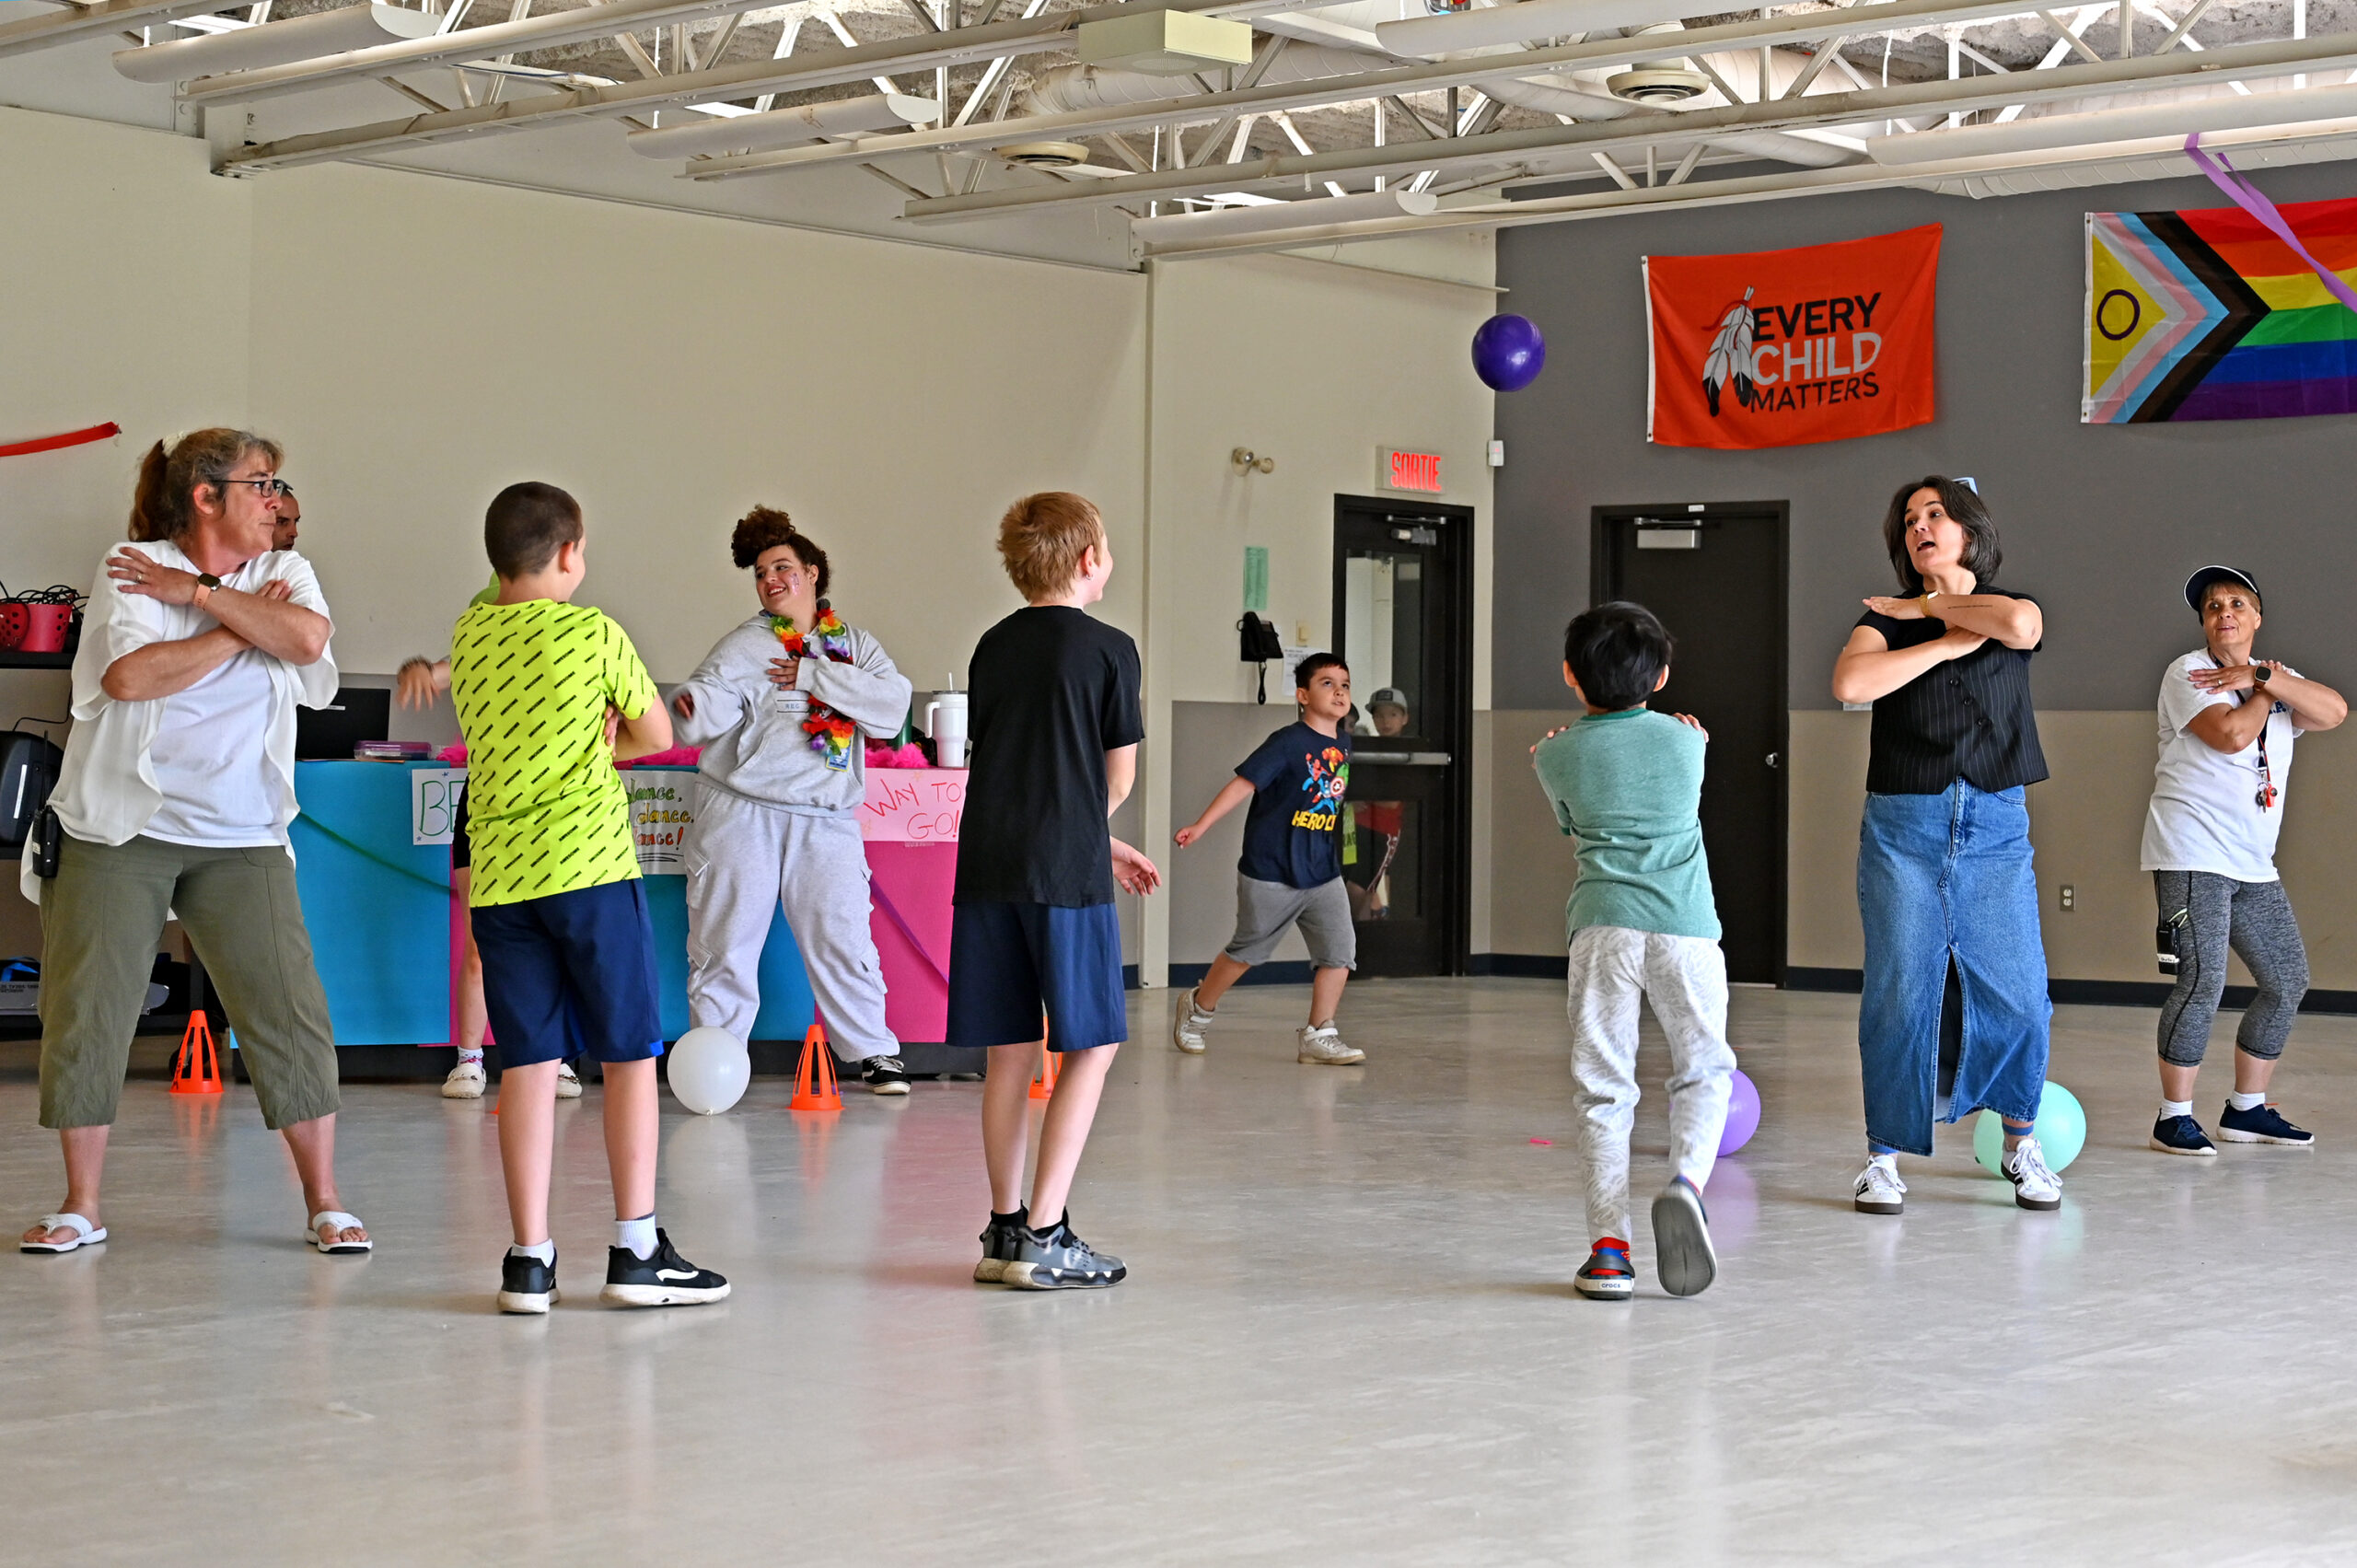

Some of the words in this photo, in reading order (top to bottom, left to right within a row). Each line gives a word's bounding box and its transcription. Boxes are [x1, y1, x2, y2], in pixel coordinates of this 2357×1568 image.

[1752, 291, 1882, 343] EVERY
[1751, 331, 1882, 386] CHILD
[1750, 371, 1880, 413] MATTERS
[1391, 451, 1442, 492] SORTIE
[626, 778, 682, 804] dance,
[864, 779, 920, 817] WAY
[931, 782, 962, 802] TO
[907, 809, 959, 839] GO!
[1292, 810, 1326, 830] HERO
